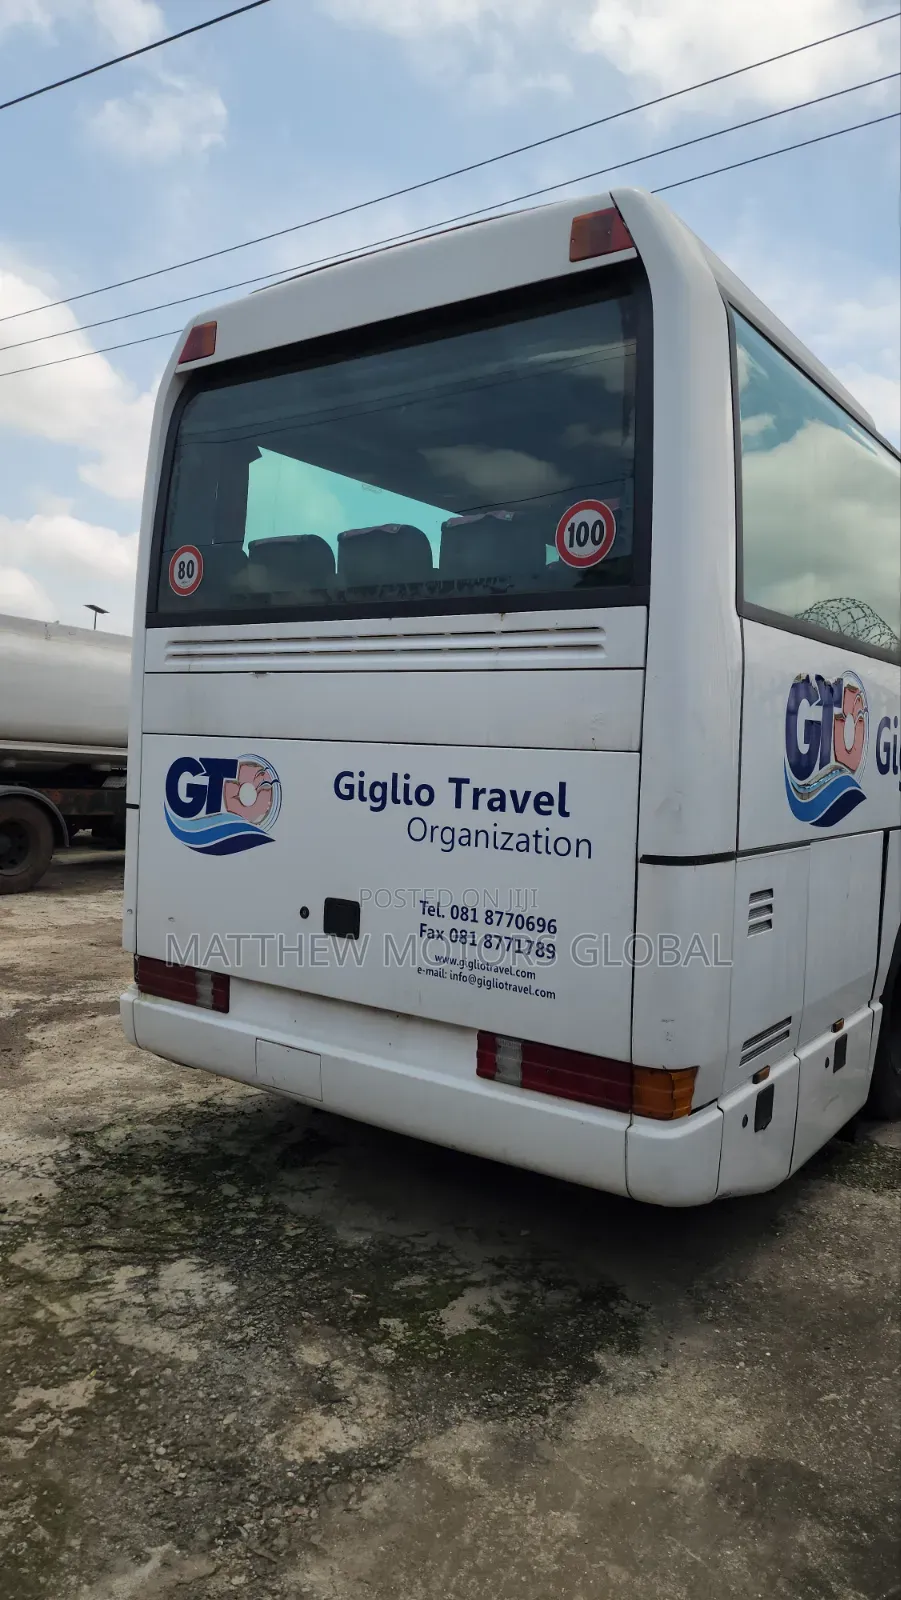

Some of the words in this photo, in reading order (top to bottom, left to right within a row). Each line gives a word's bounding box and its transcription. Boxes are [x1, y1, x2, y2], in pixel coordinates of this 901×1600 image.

[568, 520, 605, 548] 100
[178, 560, 195, 579] 80
[876, 716, 901, 791] Gi
[333, 770, 435, 813] Giglio
[448, 777, 570, 818] Travel
[407, 816, 592, 859] Organization
[419, 900, 446, 919] Tel.
[450, 905, 479, 923] 081
[484, 909, 558, 934] 8770696
[419, 922, 445, 941] Fax
[449, 928, 478, 946] 081
[483, 934, 556, 960] 8771789
[417, 964, 447, 980] e-mail:
[449, 970, 556, 1000] info@gigliotravel.com
[434, 953, 536, 980] www.gigliotravel.com
